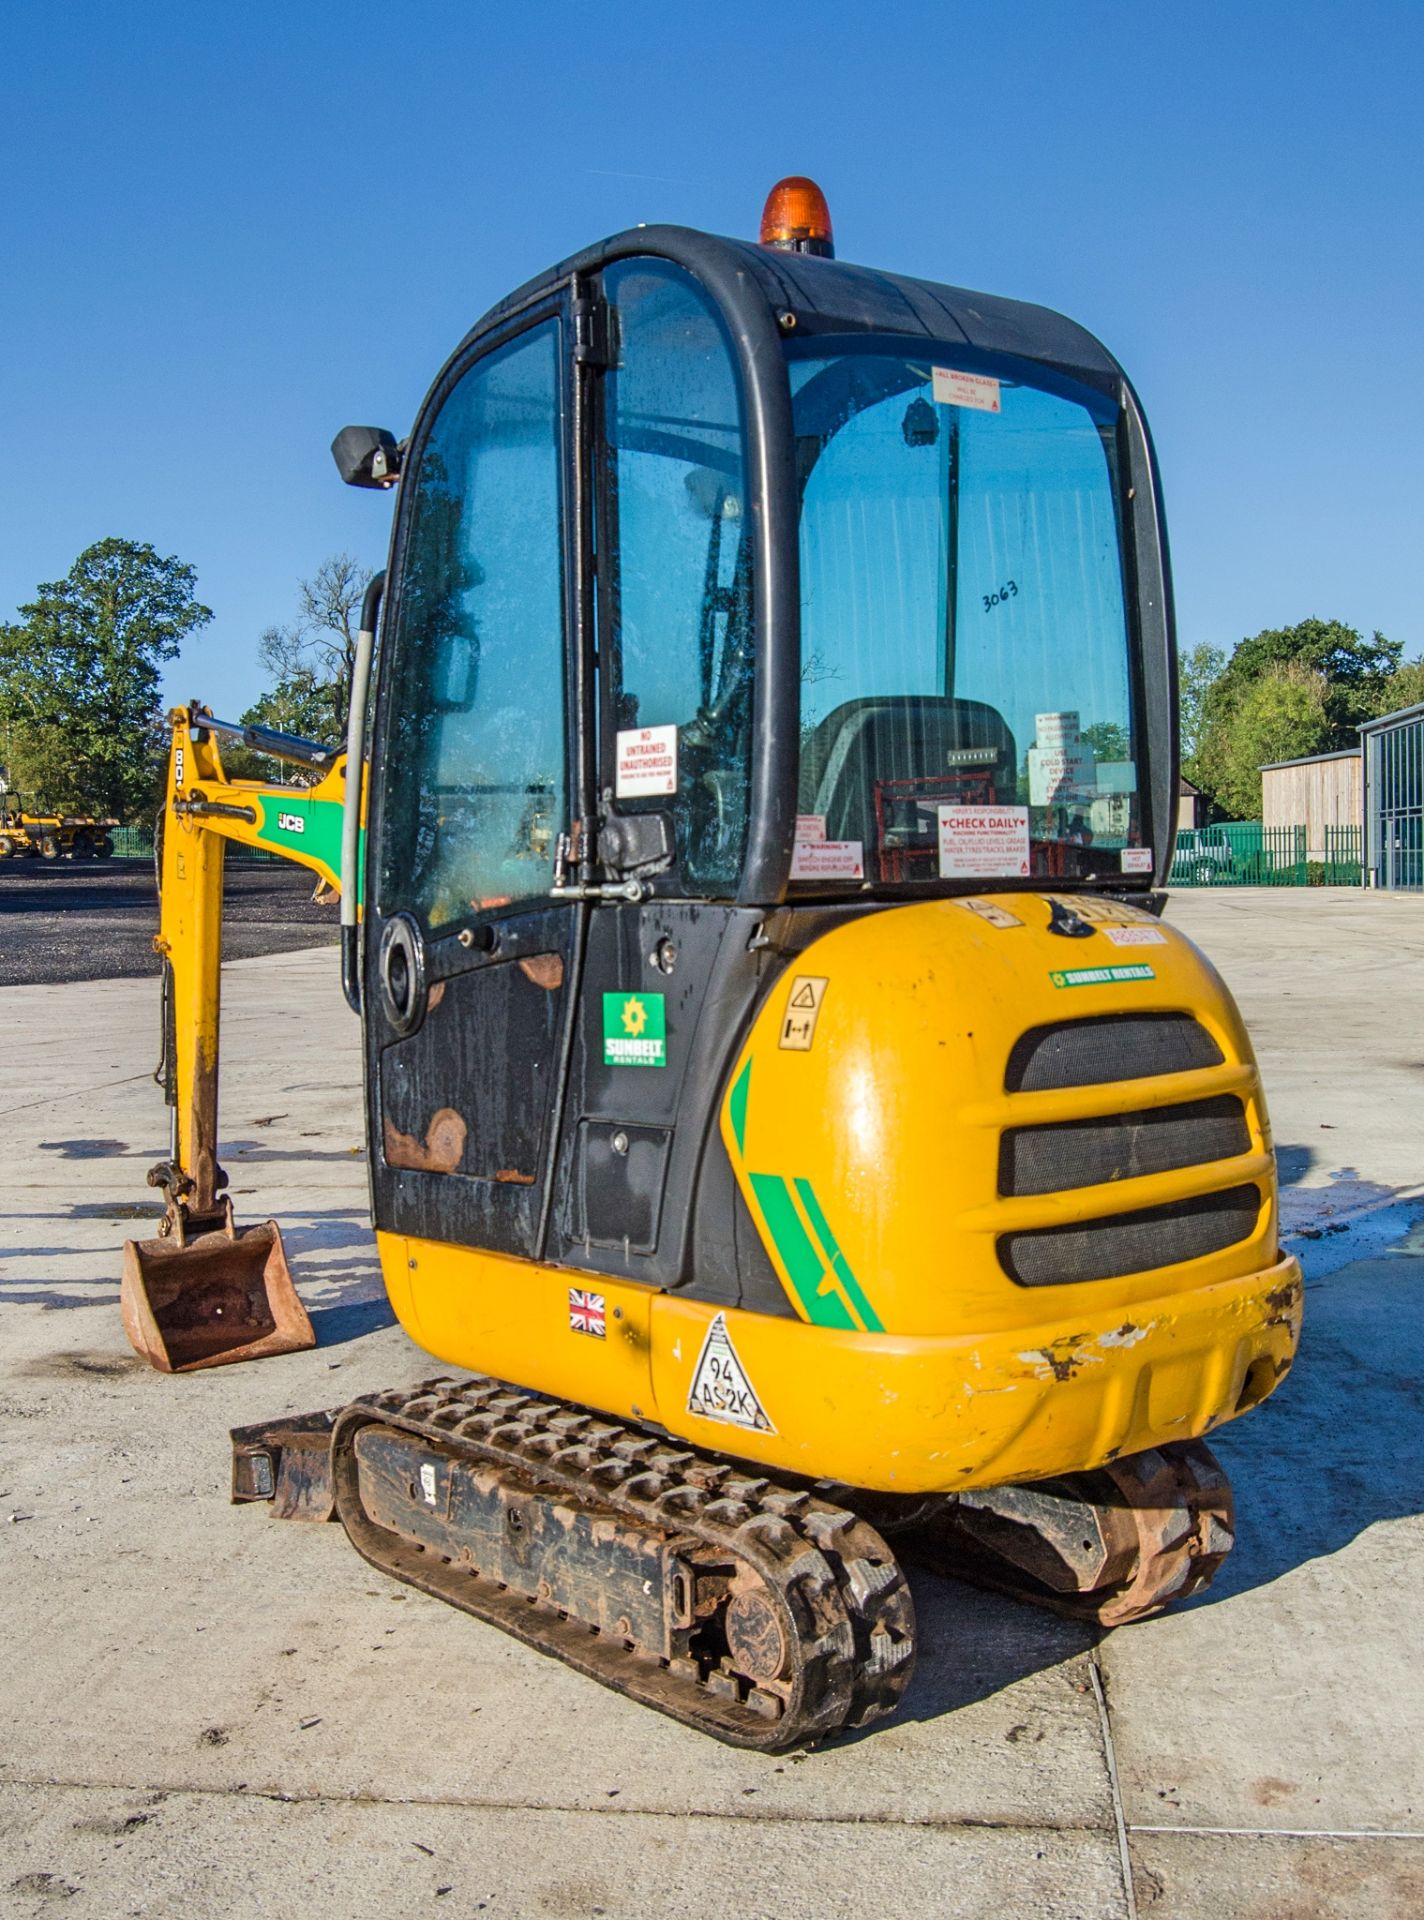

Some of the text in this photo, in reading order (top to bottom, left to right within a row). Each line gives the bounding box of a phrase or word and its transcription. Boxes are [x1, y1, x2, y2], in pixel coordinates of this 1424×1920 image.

[982, 580, 1018, 613] 3063
[640, 730, 651, 740] NO
[626, 742, 666, 757] UNTRAINED
[620, 756, 672, 770] UNAUTHORISED
[1040, 758, 1082, 767] COLD START
[278, 813, 304, 834] JCB
[949, 818, 1020, 828] CHECK DAILY
[1065, 965, 1155, 984] SUNBELT RENTALS
[605, 1038, 663, 1057] SUNBELT
[613, 1056, 655, 1064] RENTALS
